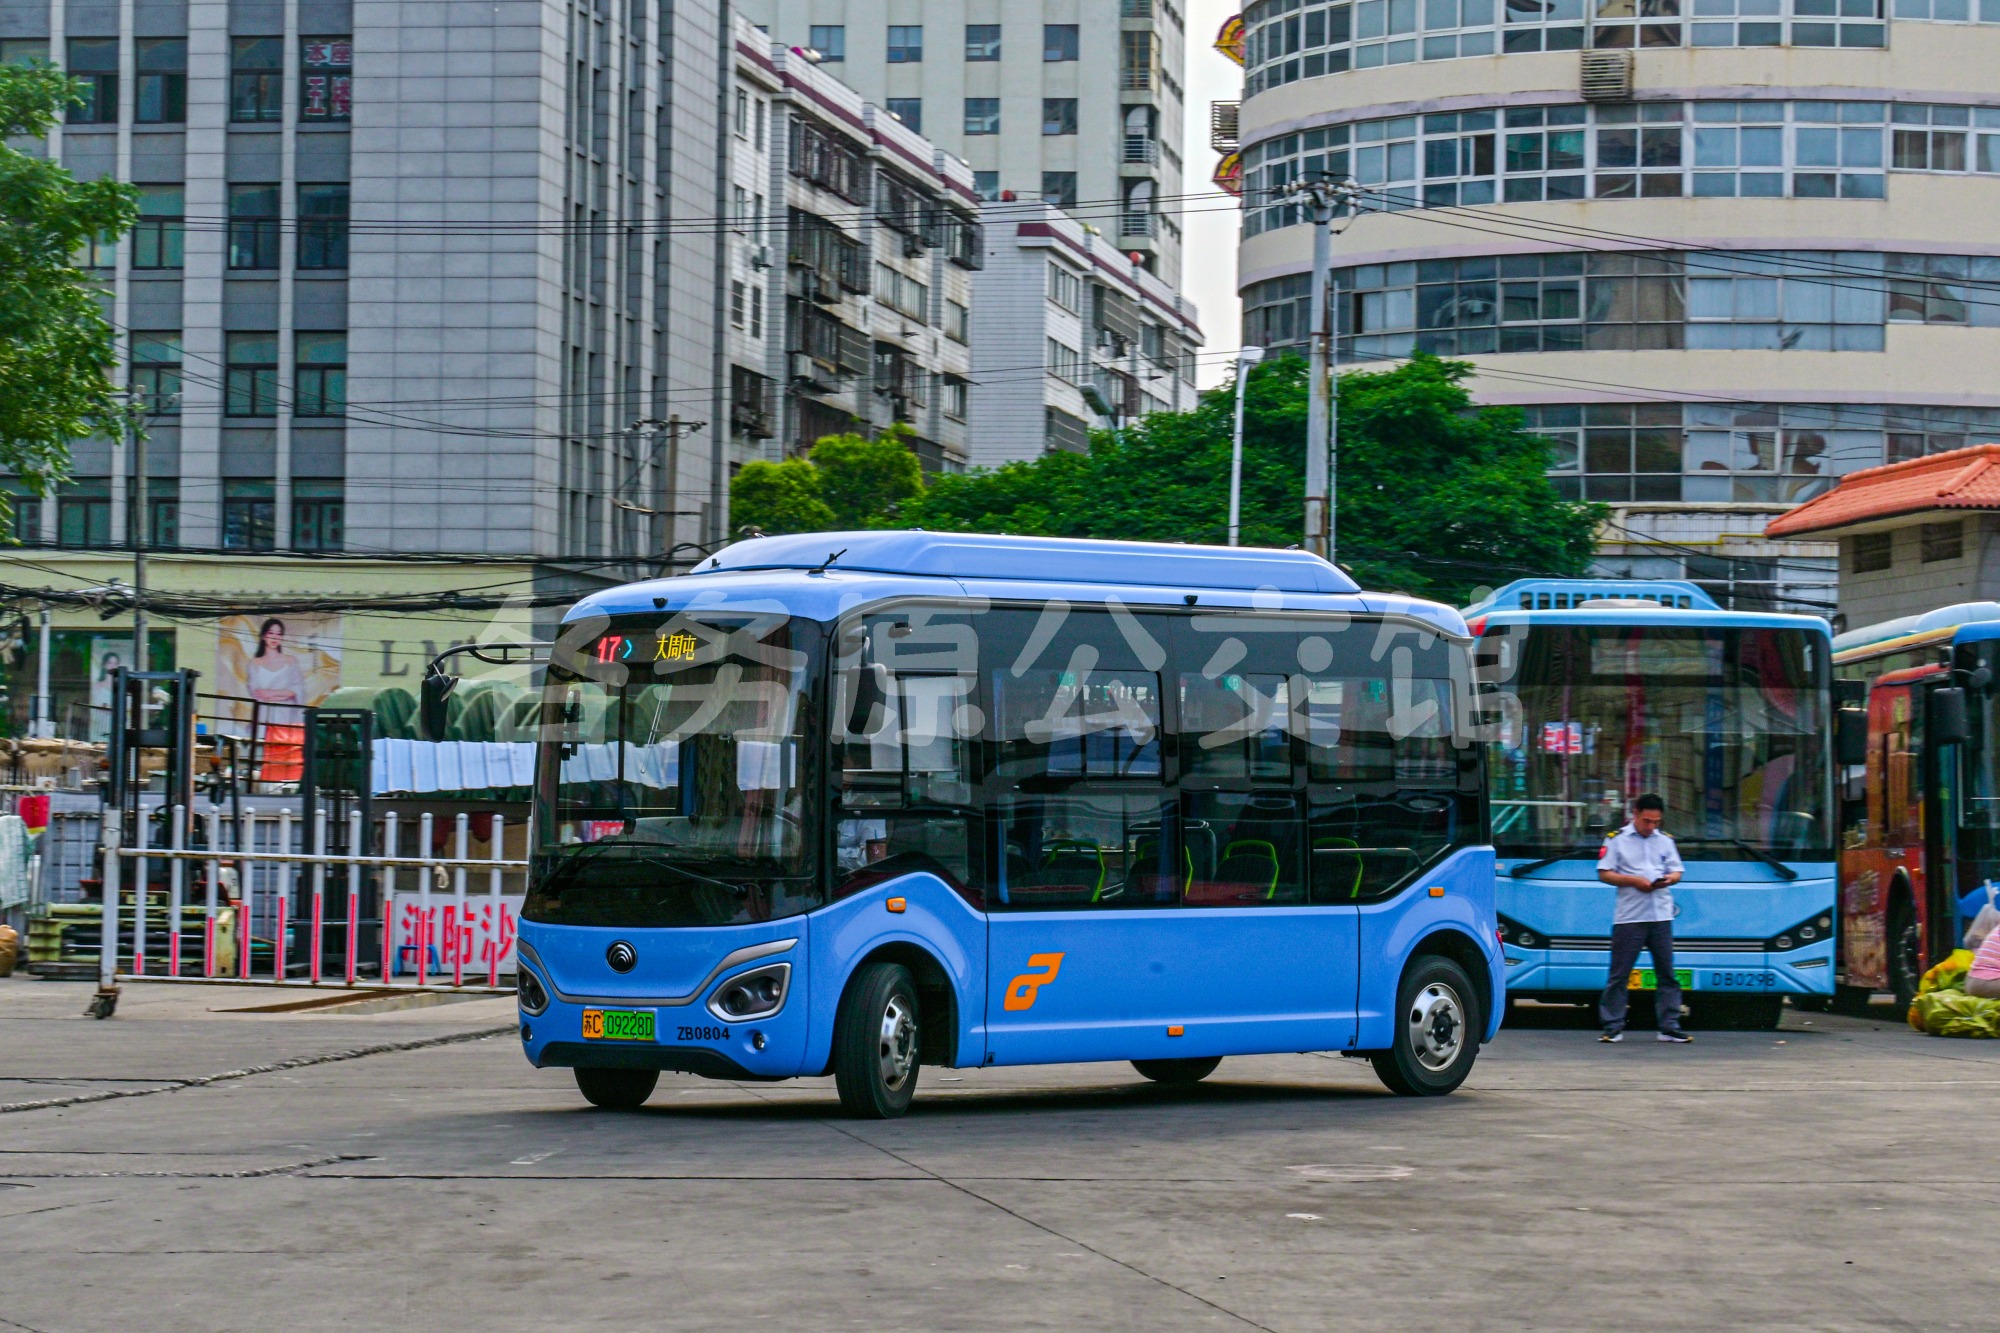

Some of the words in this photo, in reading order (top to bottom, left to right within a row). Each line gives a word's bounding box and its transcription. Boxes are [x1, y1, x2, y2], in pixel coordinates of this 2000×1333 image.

[598, 635, 622, 663] 17
[653, 633, 697, 661] 大周屯
[401, 902, 516, 965] 消防沙
[677, 1026, 731, 1041] ZB0804
